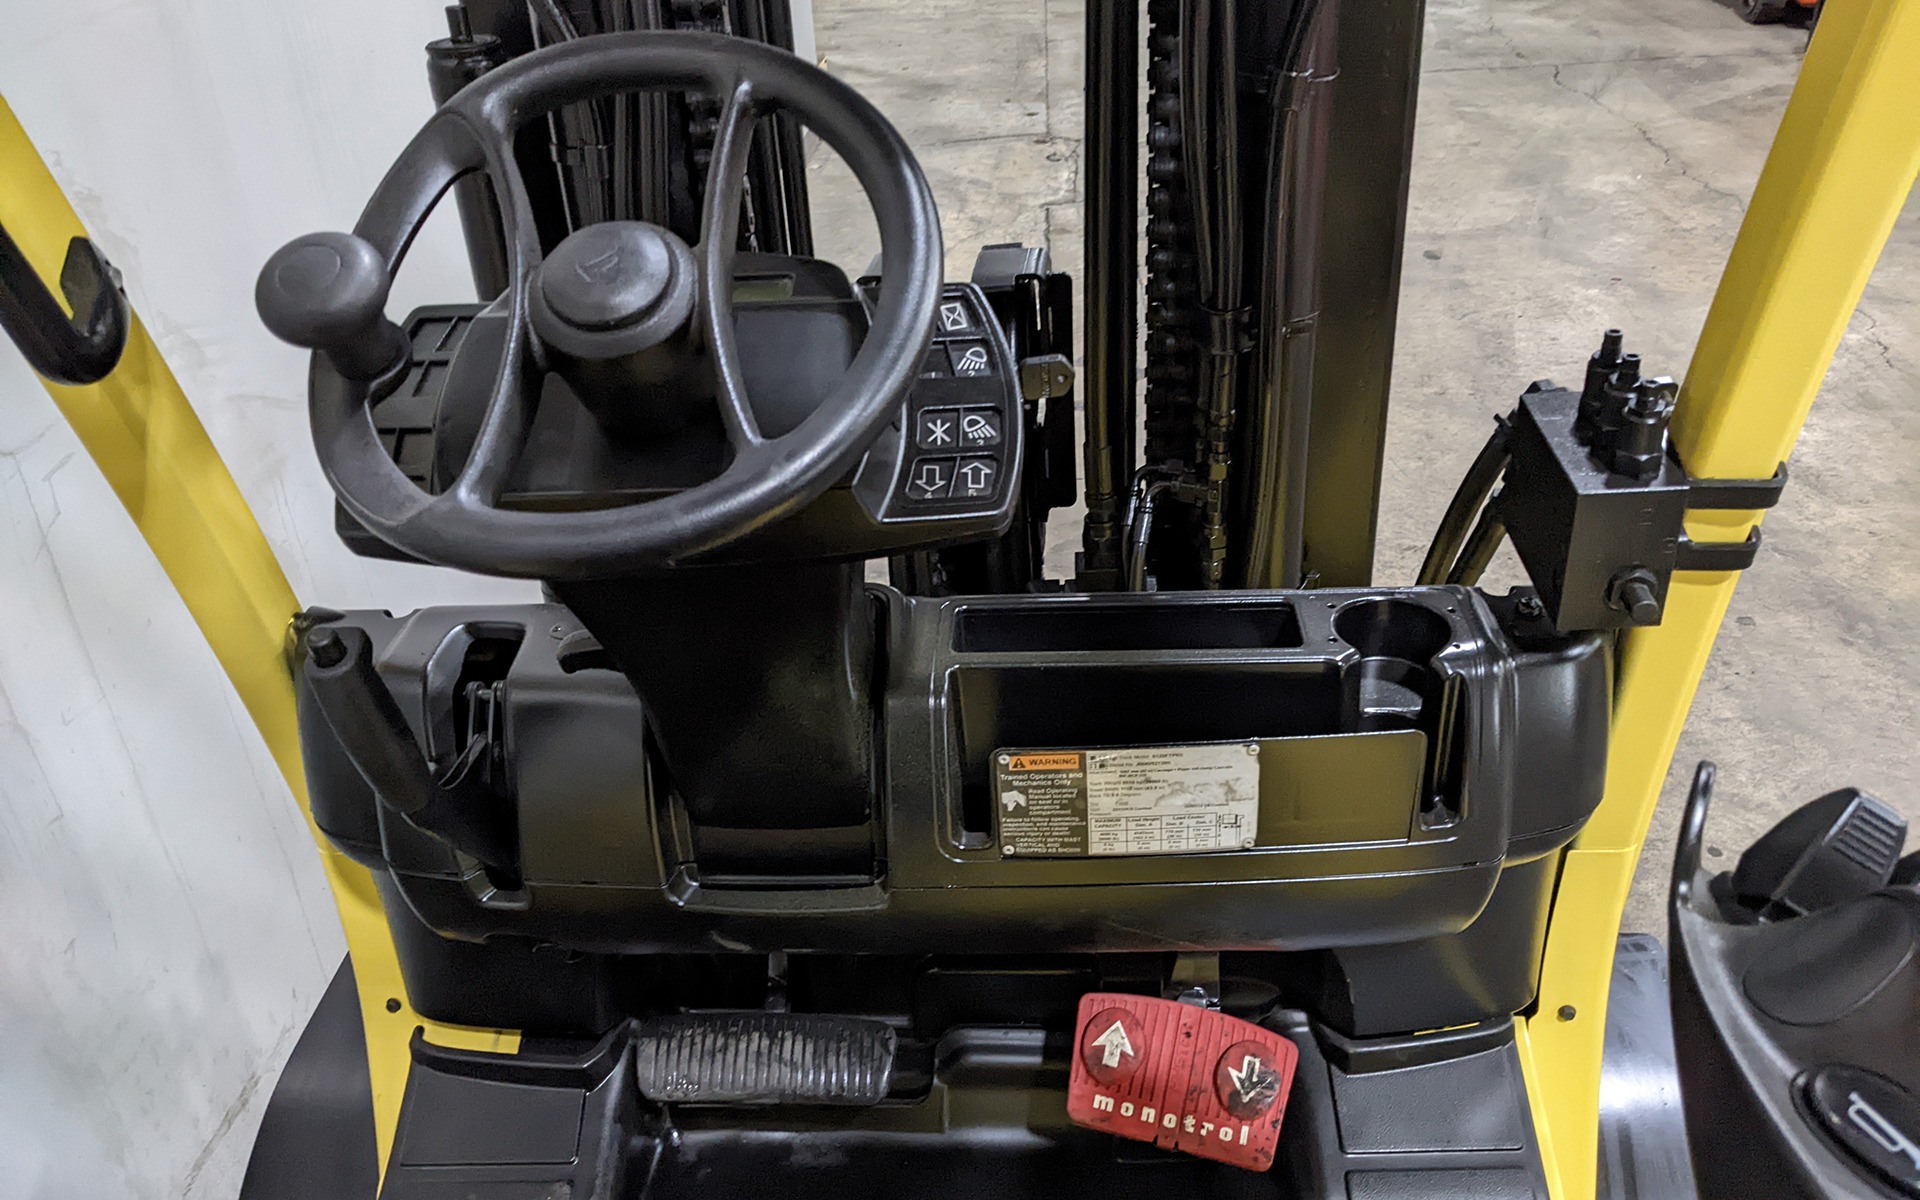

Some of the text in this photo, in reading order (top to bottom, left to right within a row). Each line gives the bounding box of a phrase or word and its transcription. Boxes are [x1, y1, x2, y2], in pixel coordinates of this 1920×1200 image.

[1028, 758, 1077, 766] WARNING
[1046, 787, 1078, 795] Operating
[1092, 1093, 1250, 1146] monotrol
